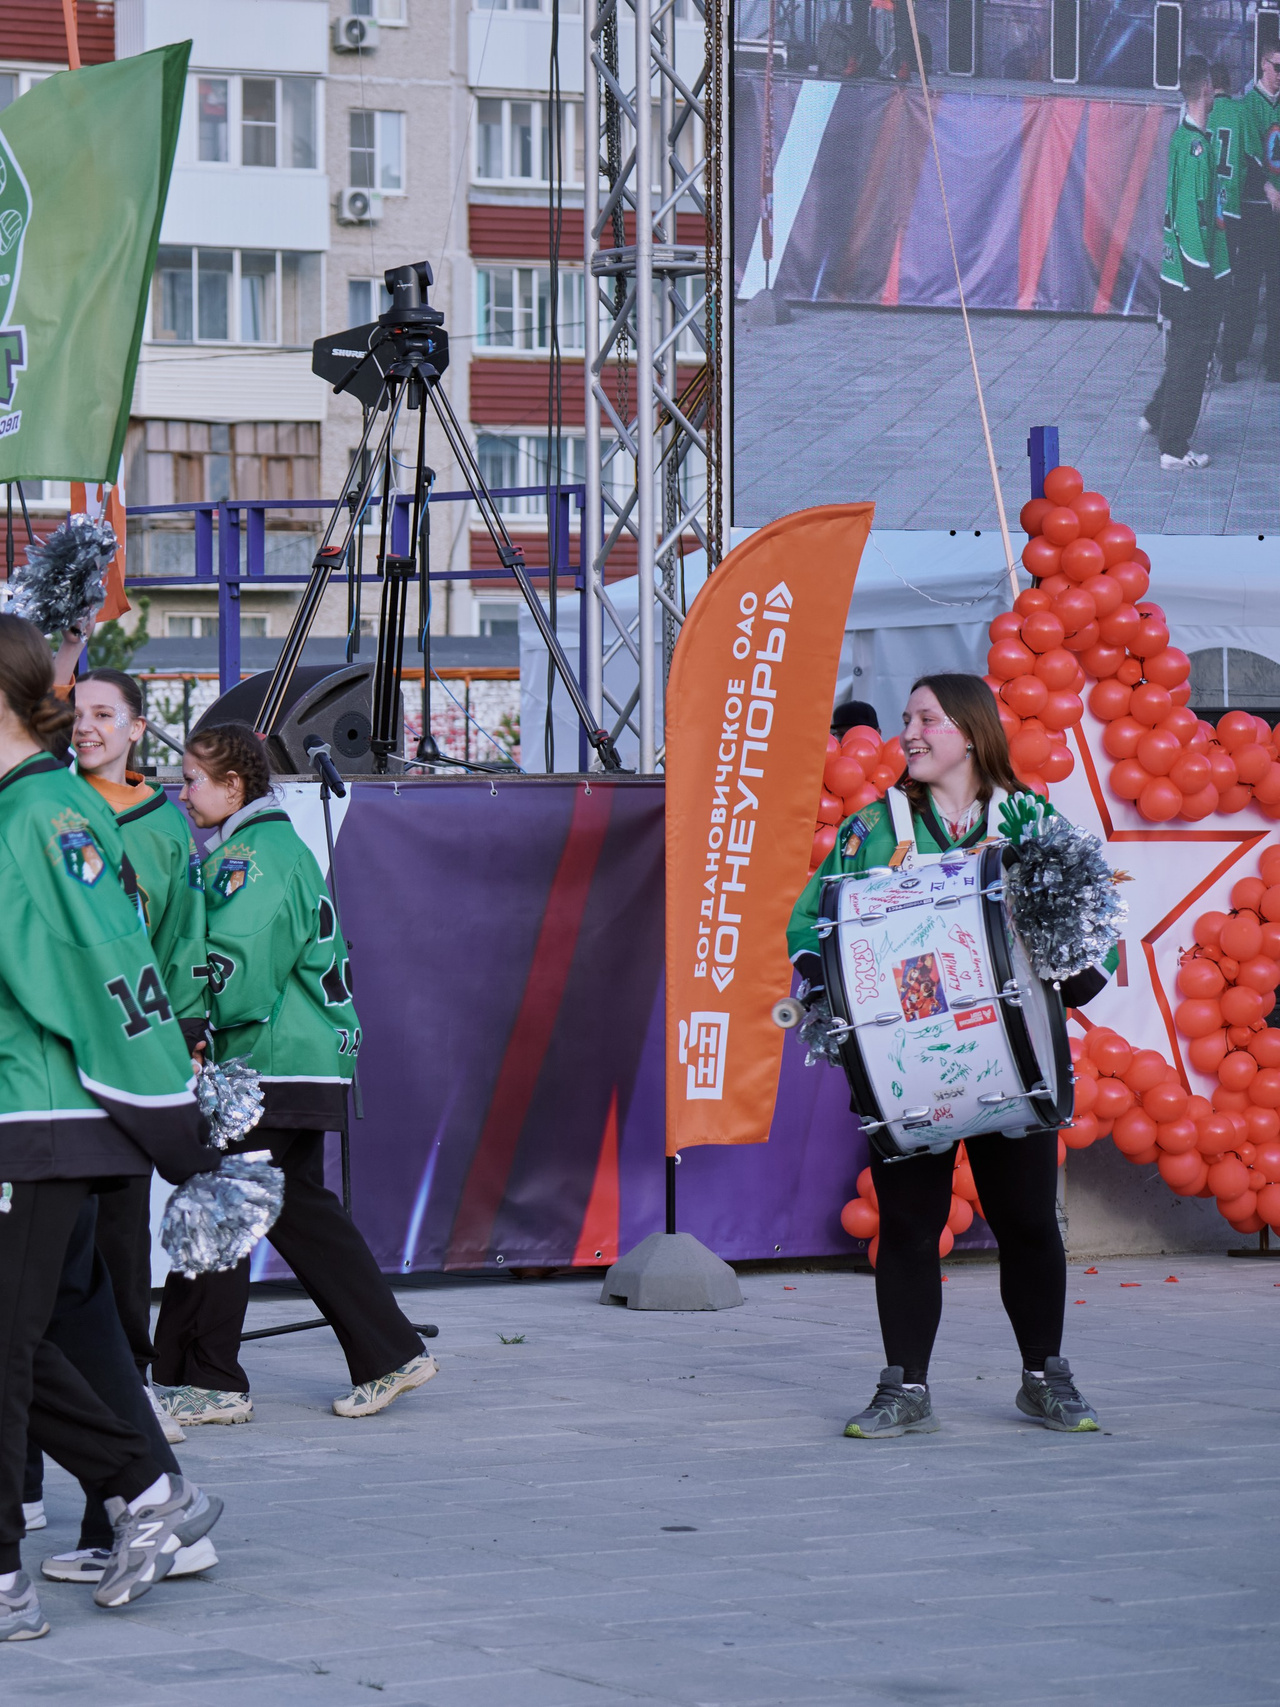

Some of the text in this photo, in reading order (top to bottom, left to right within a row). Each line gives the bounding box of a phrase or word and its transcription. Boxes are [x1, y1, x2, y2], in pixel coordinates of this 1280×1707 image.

[331, 348, 366, 359] SHURE
[694, 591, 758, 978] БОГДАНОВИЧСКОЕ ОАО
[714, 609, 790, 964] ОГНЕУПОРЫ
[104, 963, 174, 1041] 14
